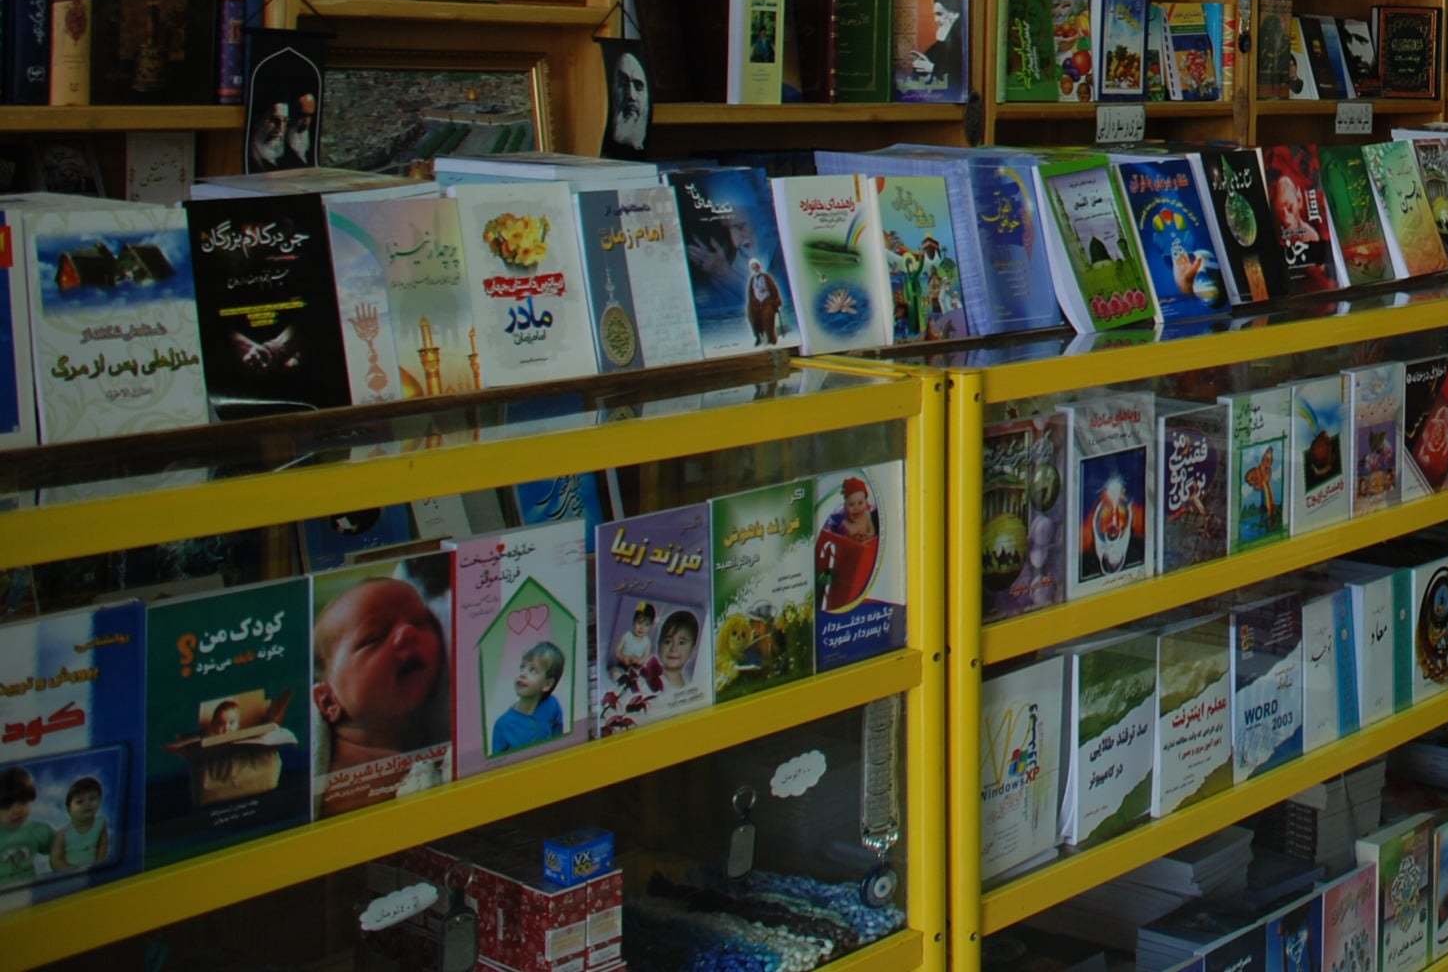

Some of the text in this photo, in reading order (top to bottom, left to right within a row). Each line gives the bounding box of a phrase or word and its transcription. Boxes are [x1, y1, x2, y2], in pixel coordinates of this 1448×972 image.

[200, 221, 311, 258] جن در کلام بزرگان
[601, 223, 665, 252] امام زمان
[505, 295, 553, 334] مادر
[52, 354, 90, 381] مرگ
[90, 354, 106, 378] از
[609, 527, 648, 567] زیبا
[648, 543, 704, 575] فرزند
[228, 610, 286, 641] کودک
[868, 606, 895, 622] چگونه
[198, 627, 230, 654] من
[1369, 622, 1389, 647] معاد
[1, 701, 85, 747] کود
[1171, 705, 1206, 731] اینترنت
[1244, 699, 1279, 726] WORD
[1271, 711, 1295, 731] 2003
[1088, 736, 1115, 763] طلایی
[326, 771, 351, 789] مادر
[350, 763, 375, 783] شیر
[1026, 765, 1041, 783] XP
[1088, 766, 1115, 790] کامپیوتر
